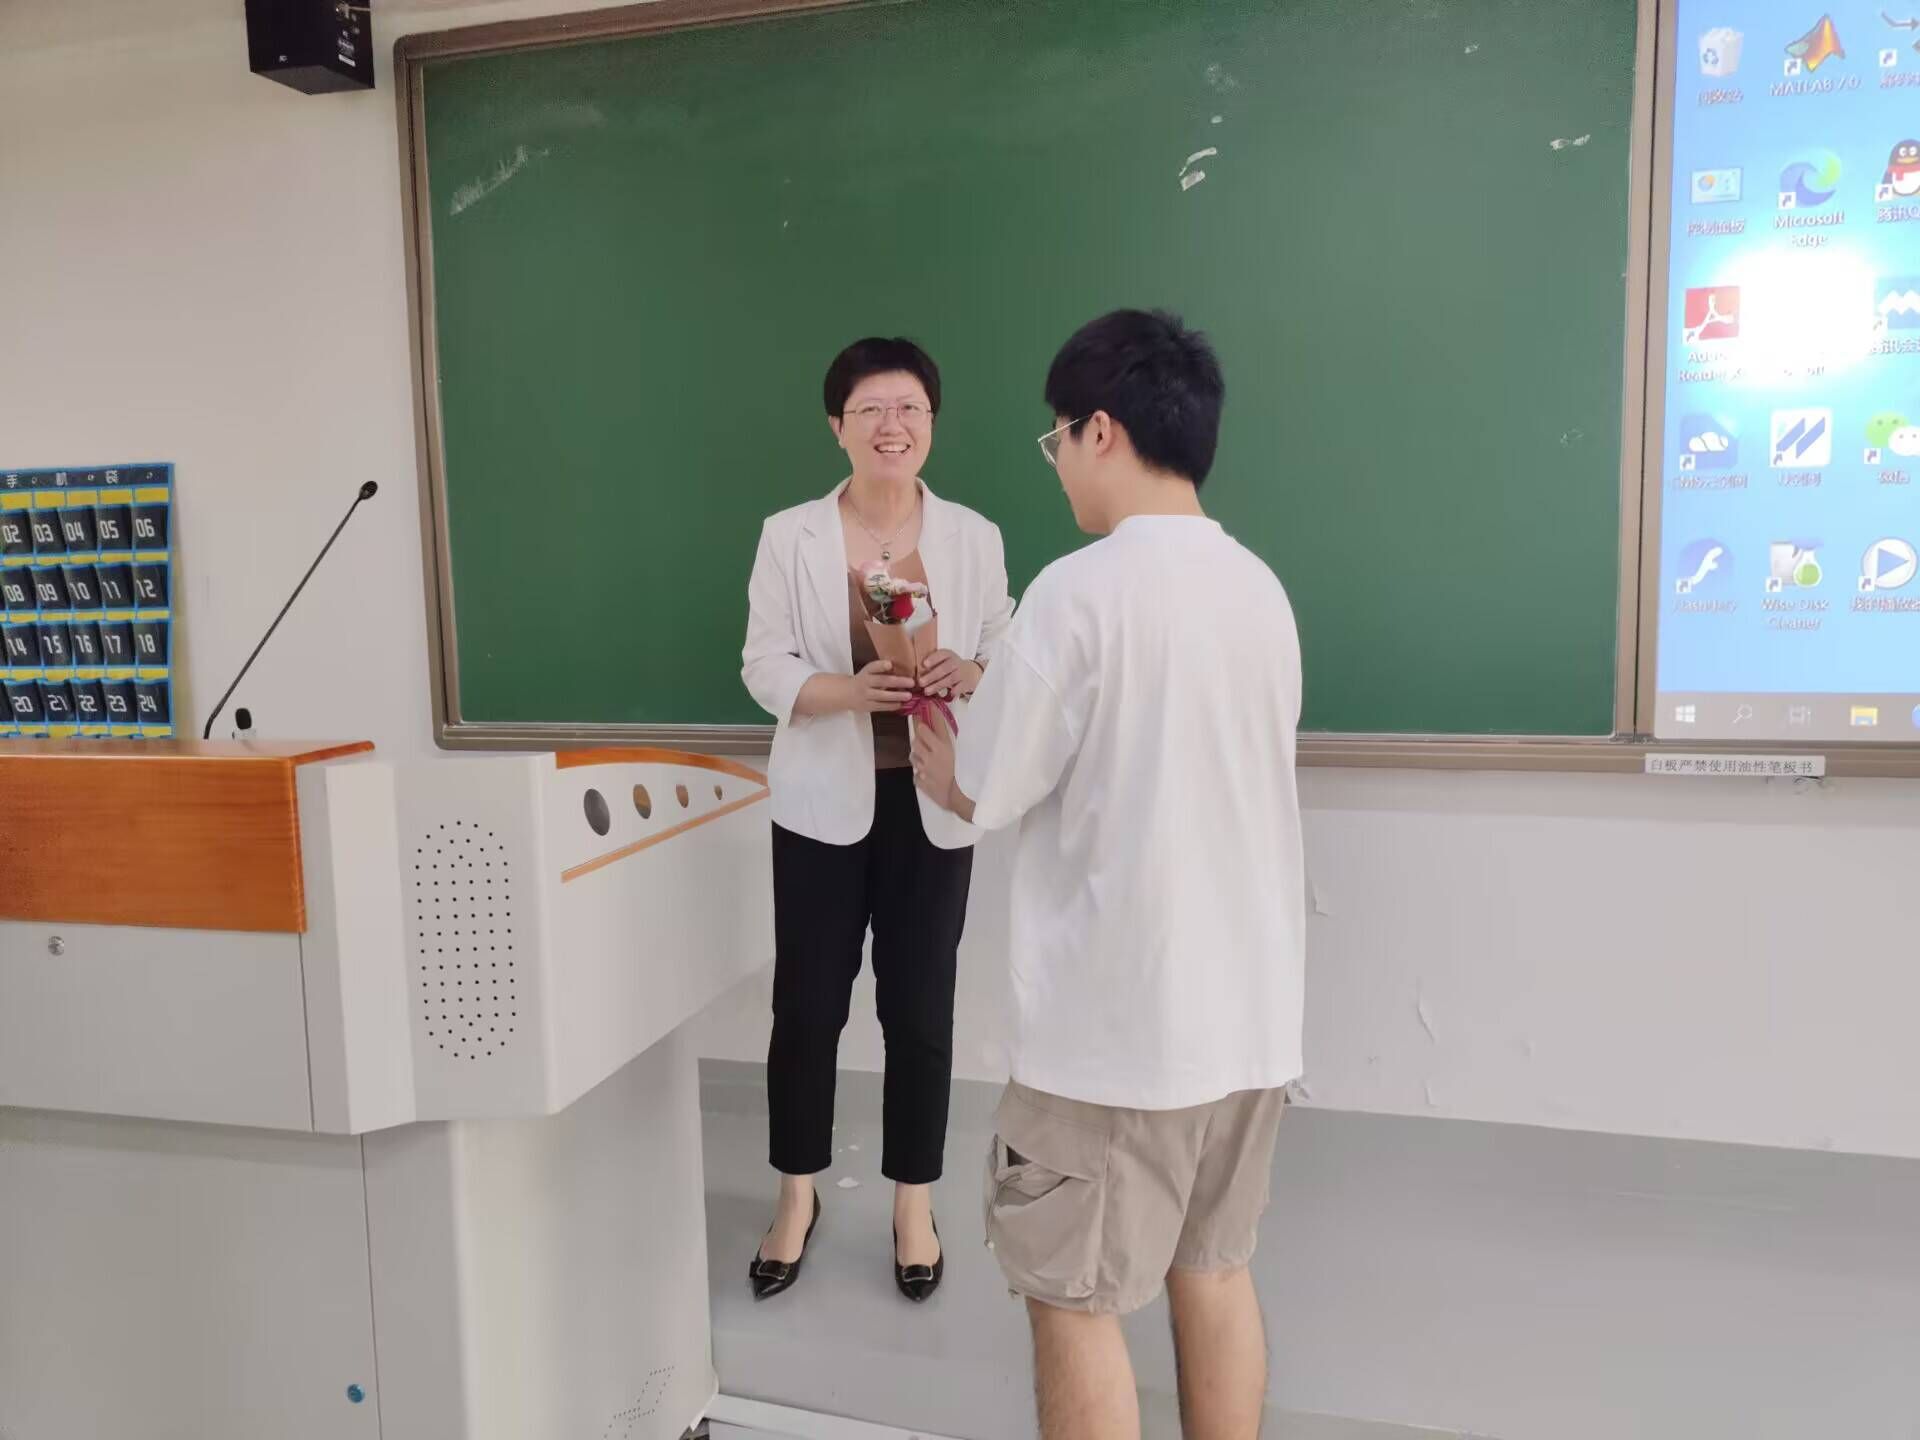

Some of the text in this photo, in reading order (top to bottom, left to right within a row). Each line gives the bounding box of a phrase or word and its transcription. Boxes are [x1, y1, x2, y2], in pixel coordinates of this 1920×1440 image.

[1775, 210, 1845, 229] Microsoft
[2, 525, 22, 543] 02
[34, 524, 54, 542] 03
[65, 522, 84, 541] 04
[100, 520, 119, 539] 05
[135, 518, 155, 537] 06
[4, 584, 25, 602] 08
[38, 583, 58, 601] 09
[70, 582, 90, 600] 10
[103, 581, 121, 599] 11
[136, 579, 157, 598] 12
[8, 638, 27, 656] 14
[44, 636, 63, 654] 15
[75, 635, 93, 653] 16
[105, 635, 121, 654] 17
[138, 634, 156, 653] 18
[12, 696, 33, 713] 20
[49, 694, 68, 711] 21
[78, 695, 97, 712] 22
[108, 695, 127, 712] 23
[140, 694, 157, 712] 24
[1651, 758, 1813, 774] 白板严禁使用油性笔板书
